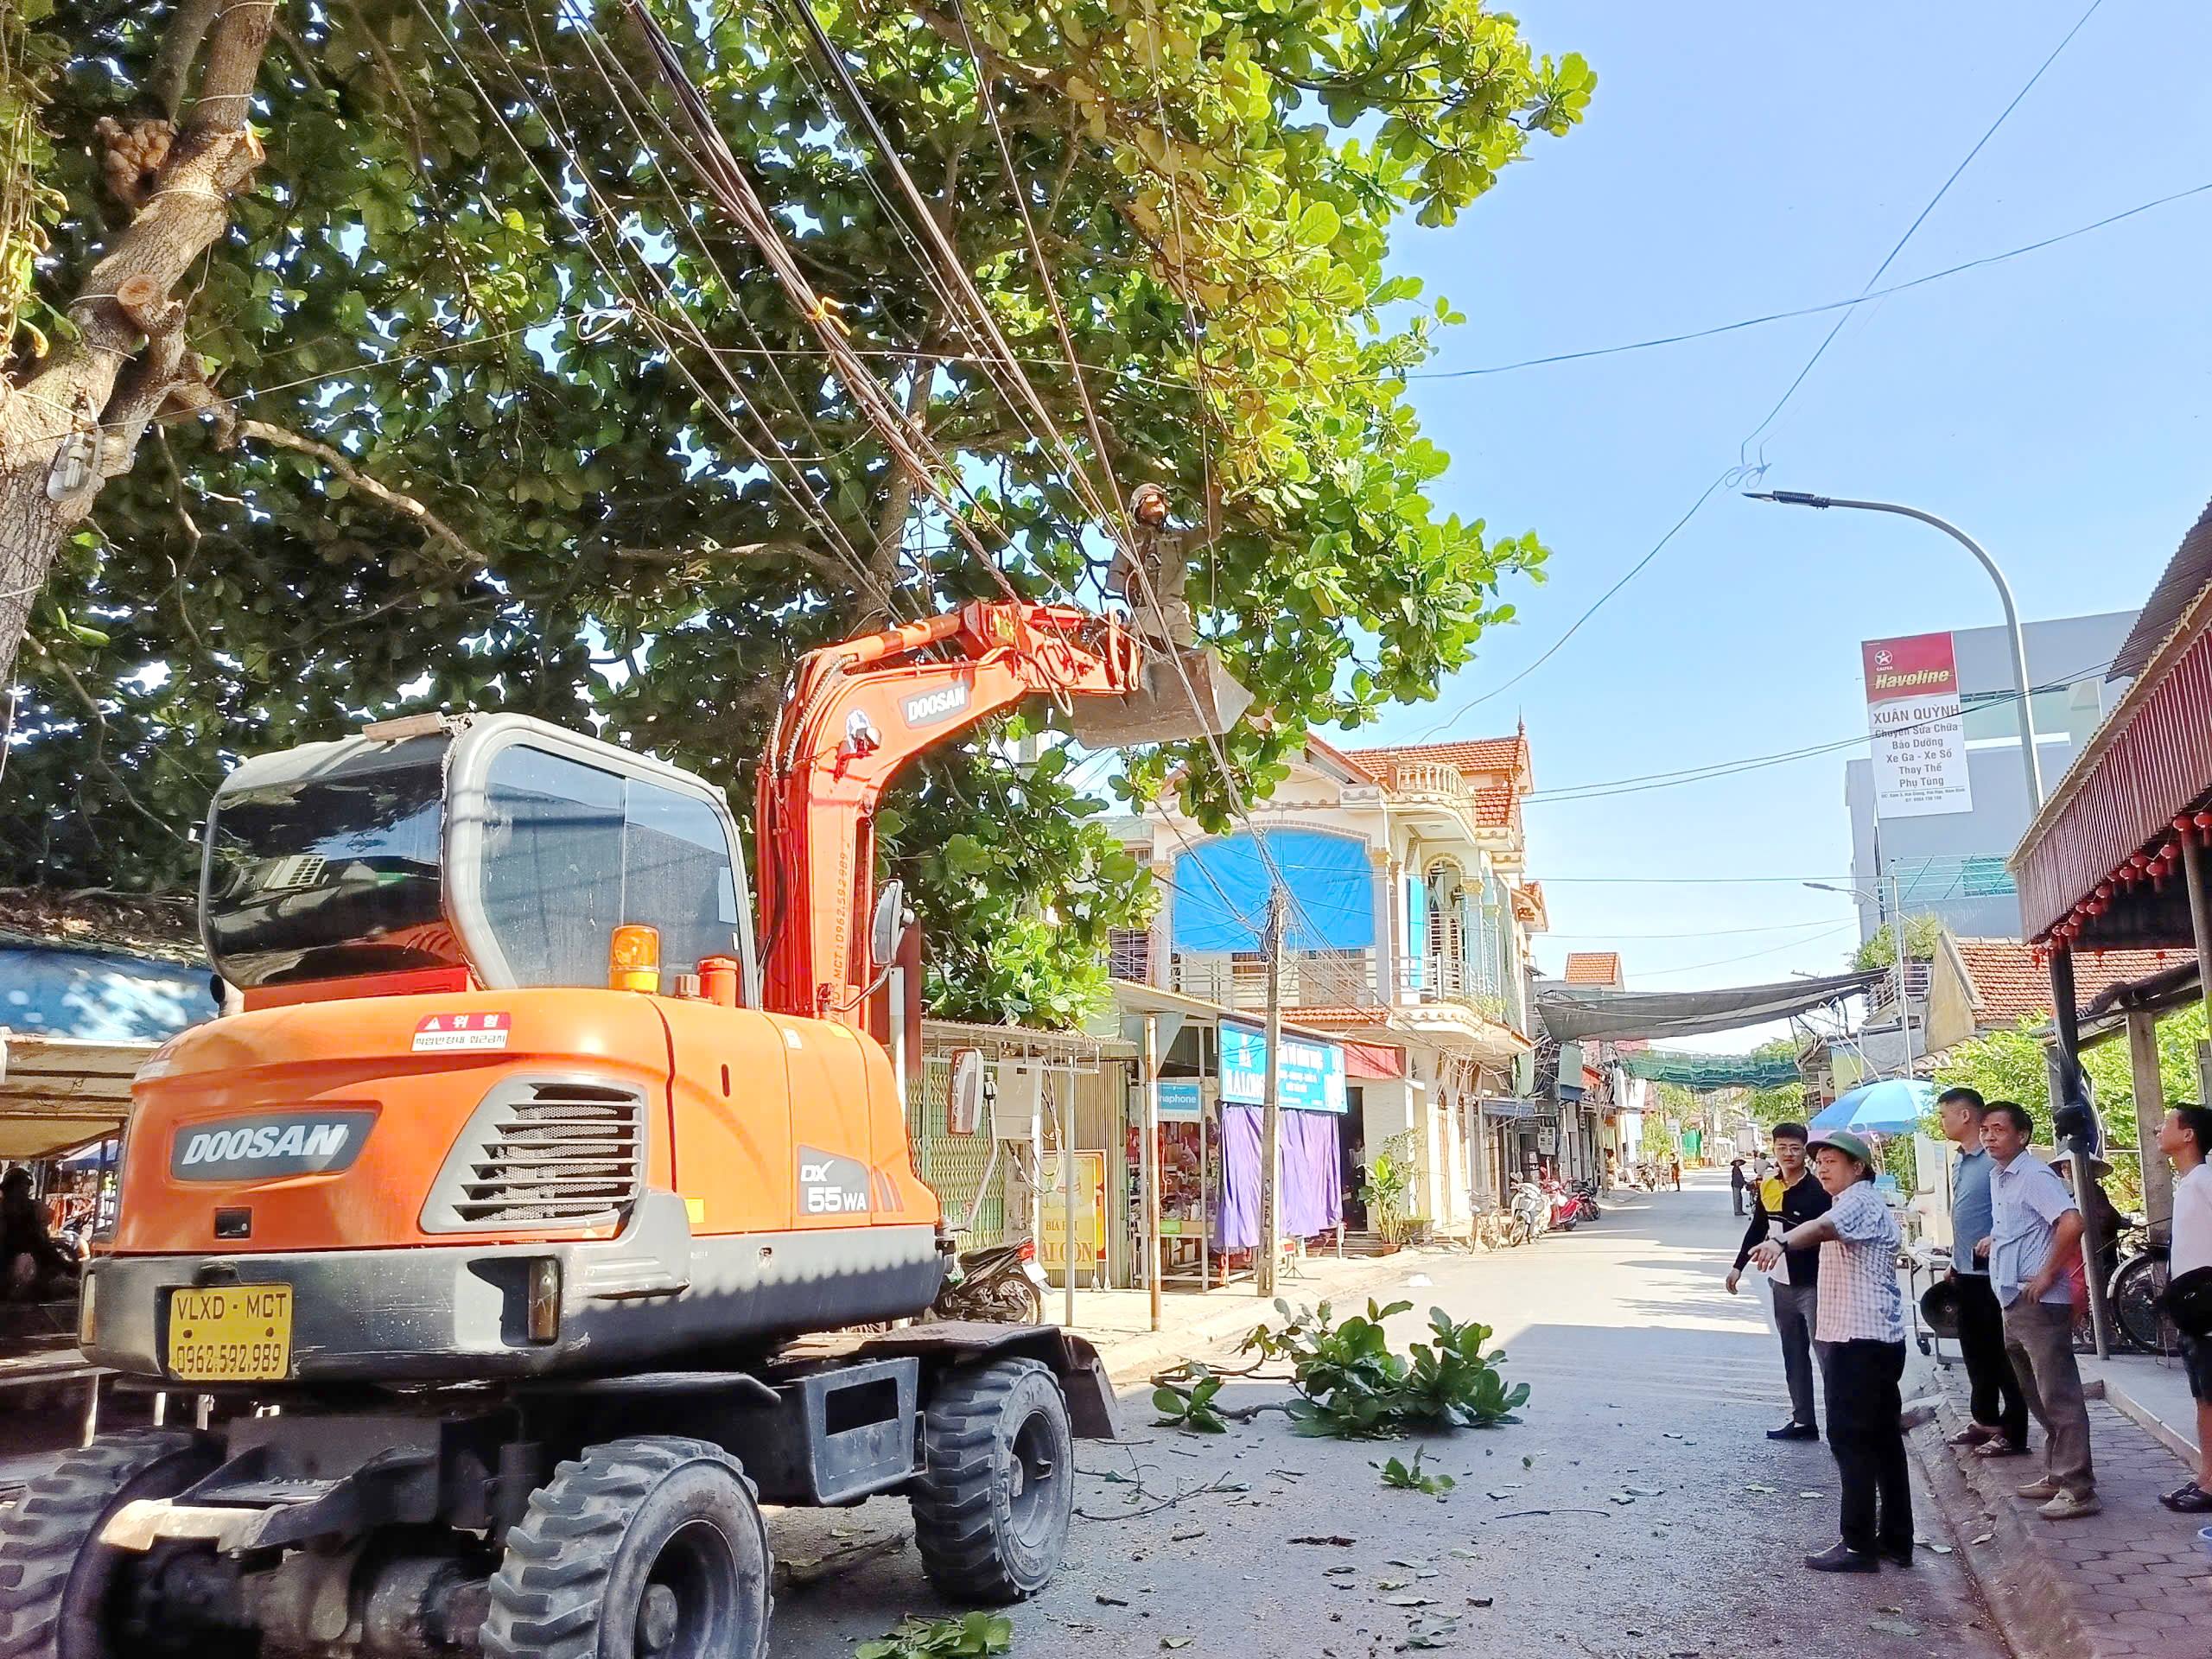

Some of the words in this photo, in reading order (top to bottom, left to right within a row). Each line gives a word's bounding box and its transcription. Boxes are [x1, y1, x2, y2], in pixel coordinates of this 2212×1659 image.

[1874, 669, 1949, 690] Havoline
[907, 686, 965, 721] DOOSAN
[1873, 708, 1909, 724] XUÂN
[1913, 703, 1960, 720] QUỲNH
[1886, 753, 1898, 763] Xe
[1901, 753, 1915, 761] Ga
[1924, 751, 1936, 760] Xe
[1939, 747, 1952, 759] Số
[1899, 766, 1922, 775] Thay
[1924, 761, 1942, 772] Thế
[1899, 779, 1917, 789] Phụ
[181, 1123, 348, 1166] DOOSAN
[800, 1160, 836, 1182] DX
[1046, 1220, 1060, 1231] BIA
[176, 1295, 226, 1320] VLXD
[246, 1293, 287, 1319] MCT
